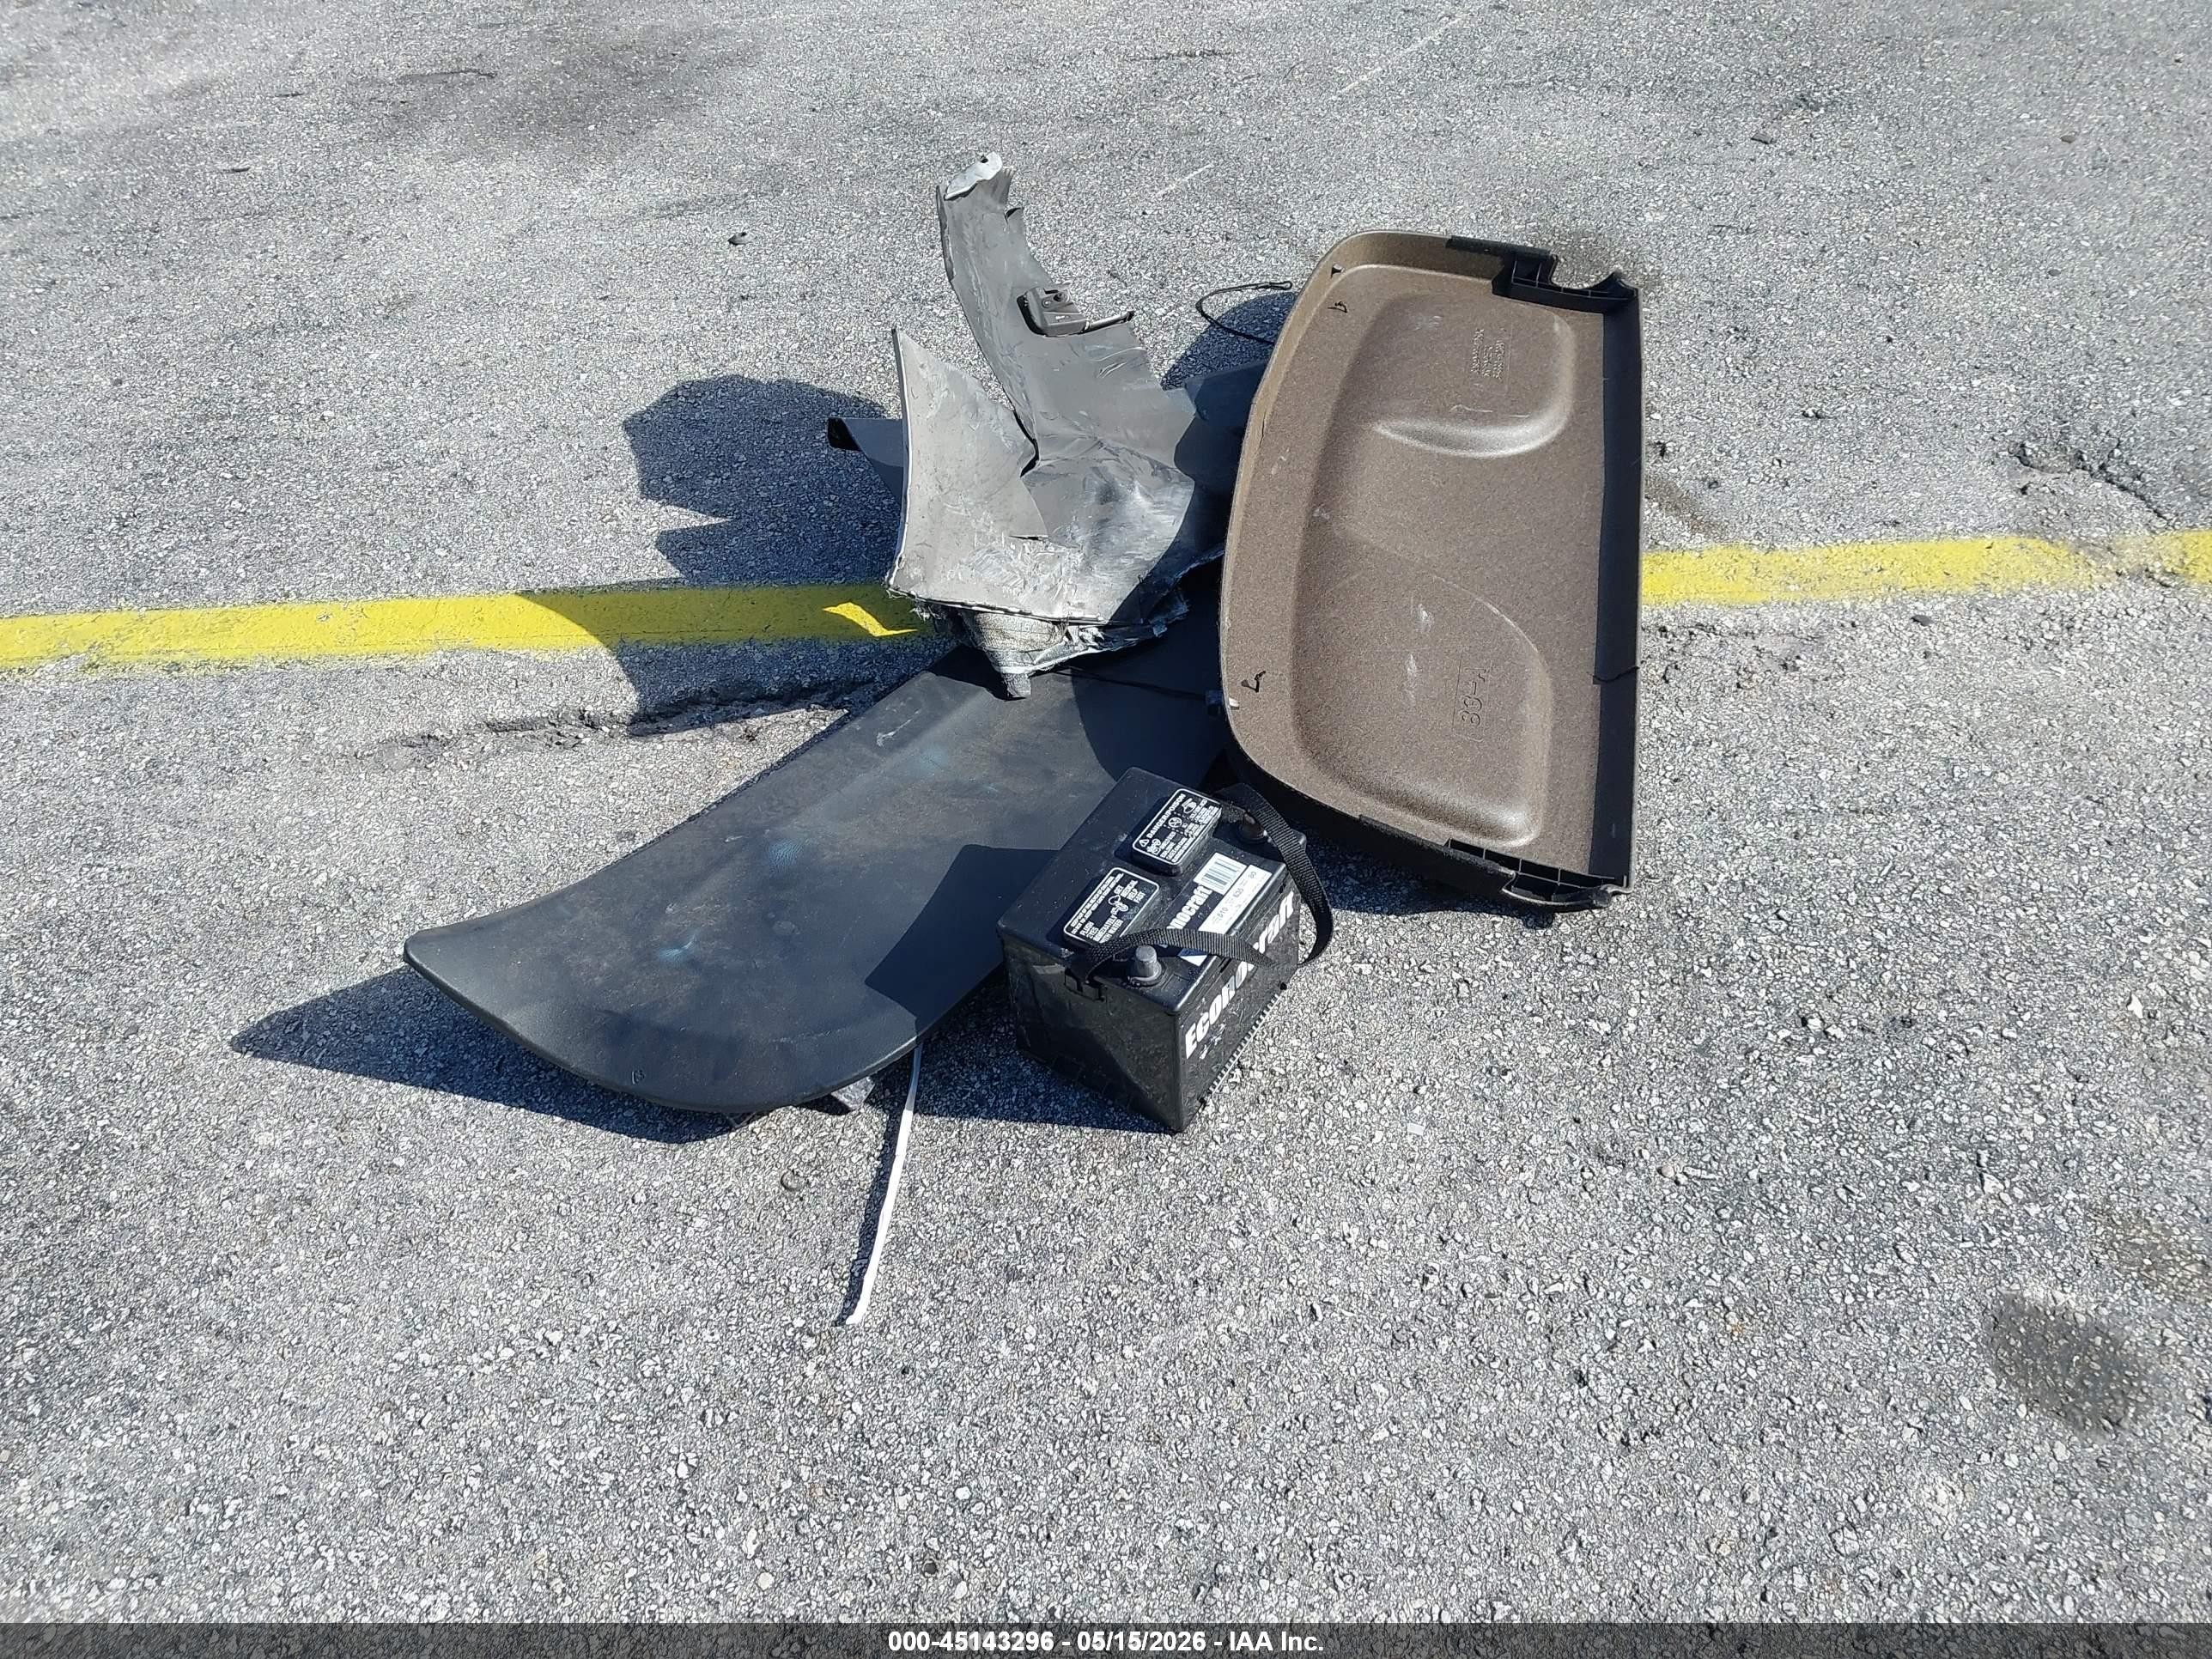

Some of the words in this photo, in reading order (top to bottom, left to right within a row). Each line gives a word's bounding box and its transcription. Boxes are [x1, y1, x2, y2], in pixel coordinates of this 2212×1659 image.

[1146, 793, 1186, 839] DANGER/POISON
[1133, 891, 1146, 903] FAST
[1184, 890, 1294, 1060] Econoraft
